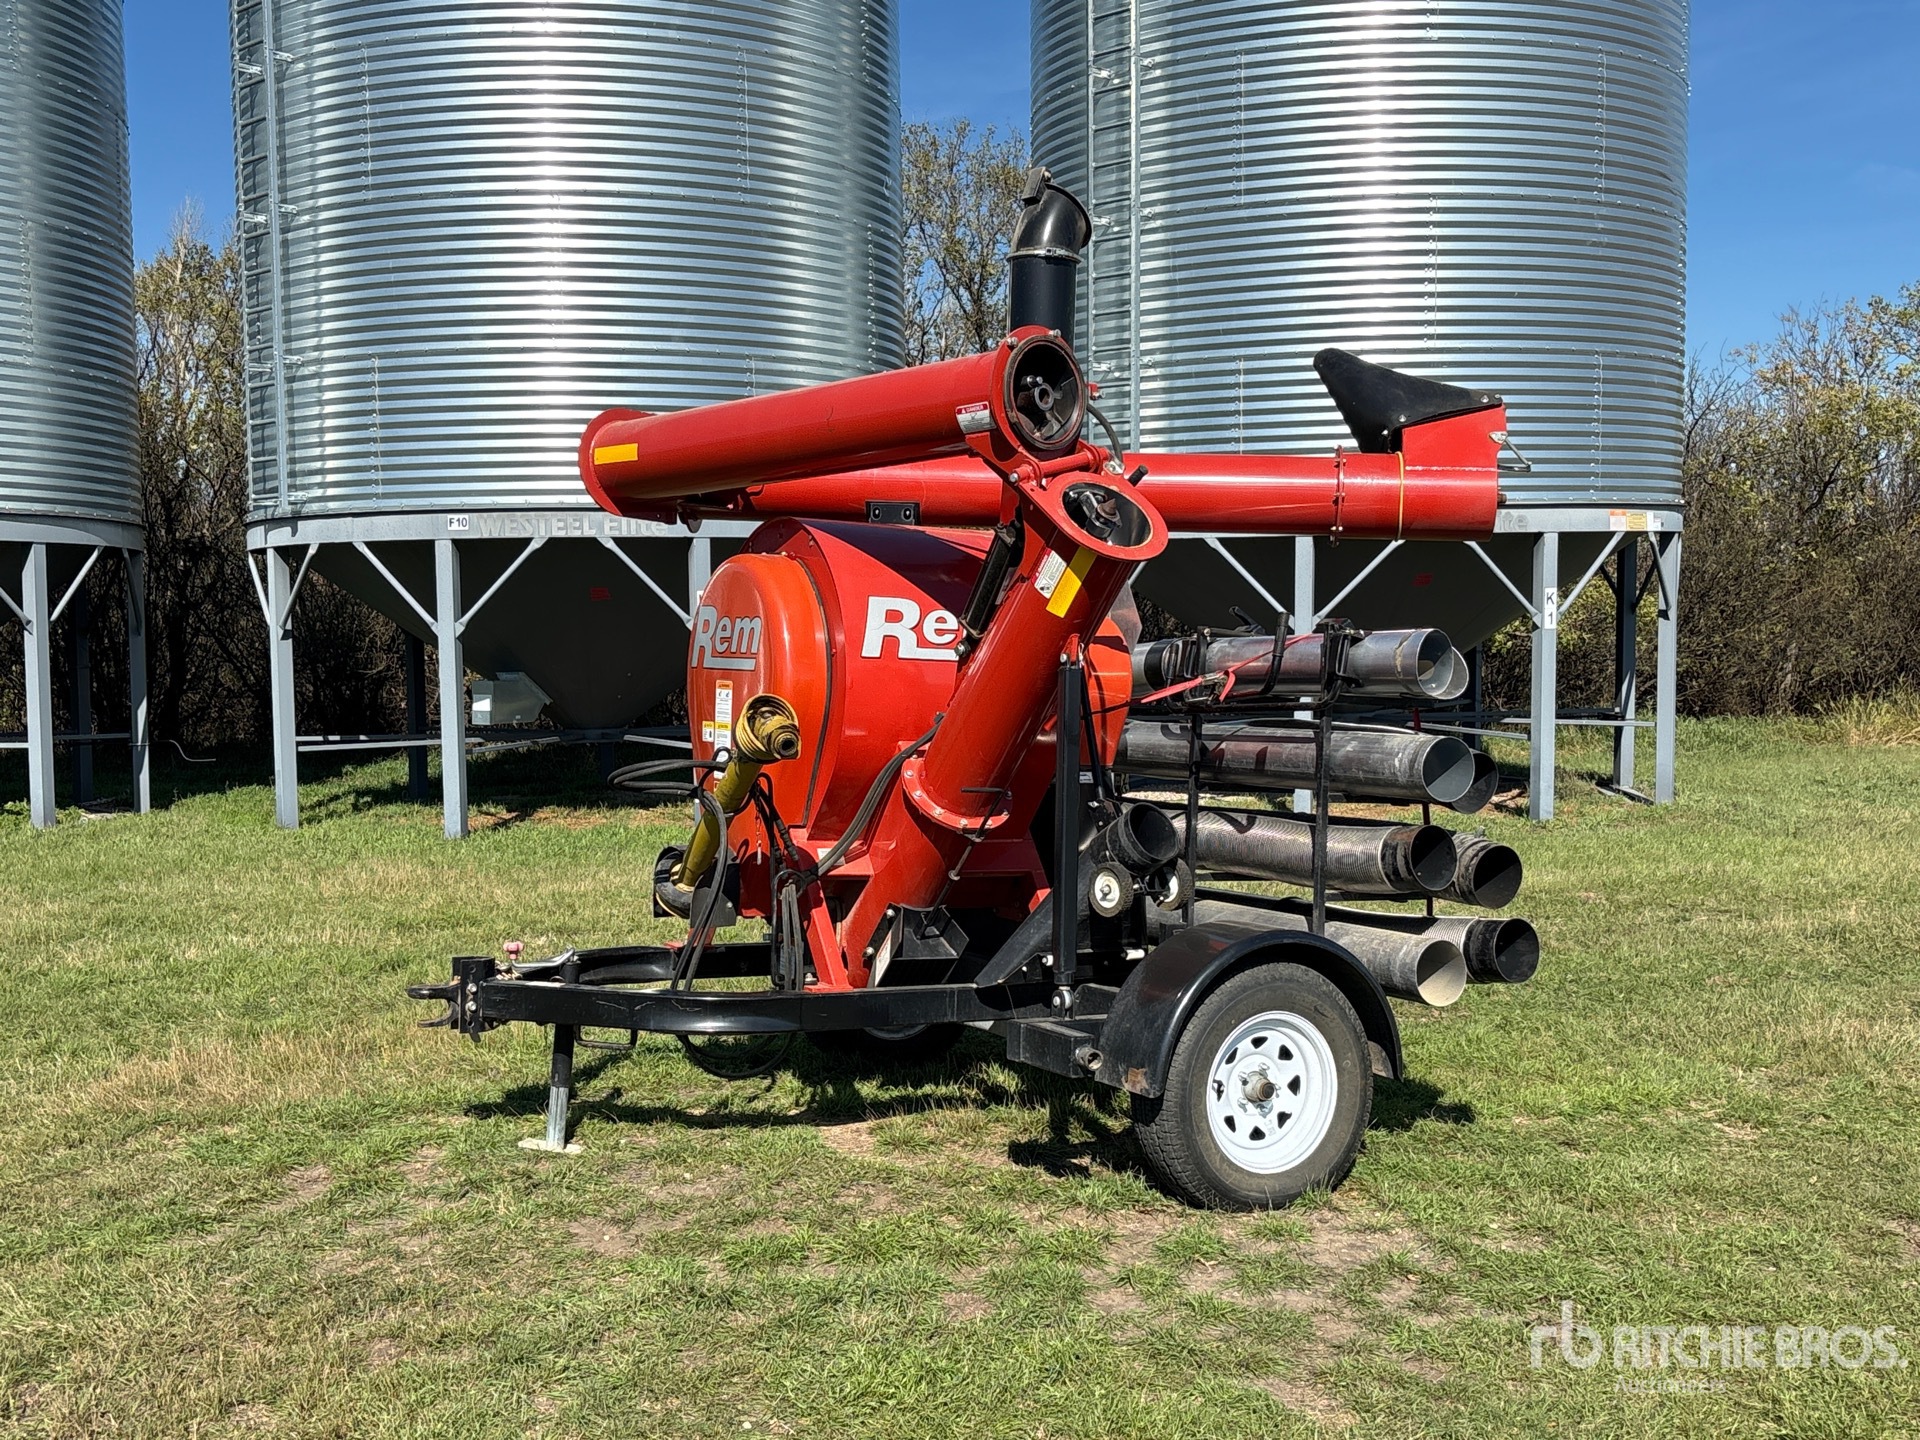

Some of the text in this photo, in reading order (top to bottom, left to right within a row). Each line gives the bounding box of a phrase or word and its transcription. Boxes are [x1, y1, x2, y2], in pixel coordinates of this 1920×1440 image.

[449, 517, 468, 529] F10
[479, 513, 669, 536] WESTEEL Elite
[1546, 592, 1556, 625] K 1
[691, 605, 763, 671] Rem
[860, 595, 967, 661] Re
